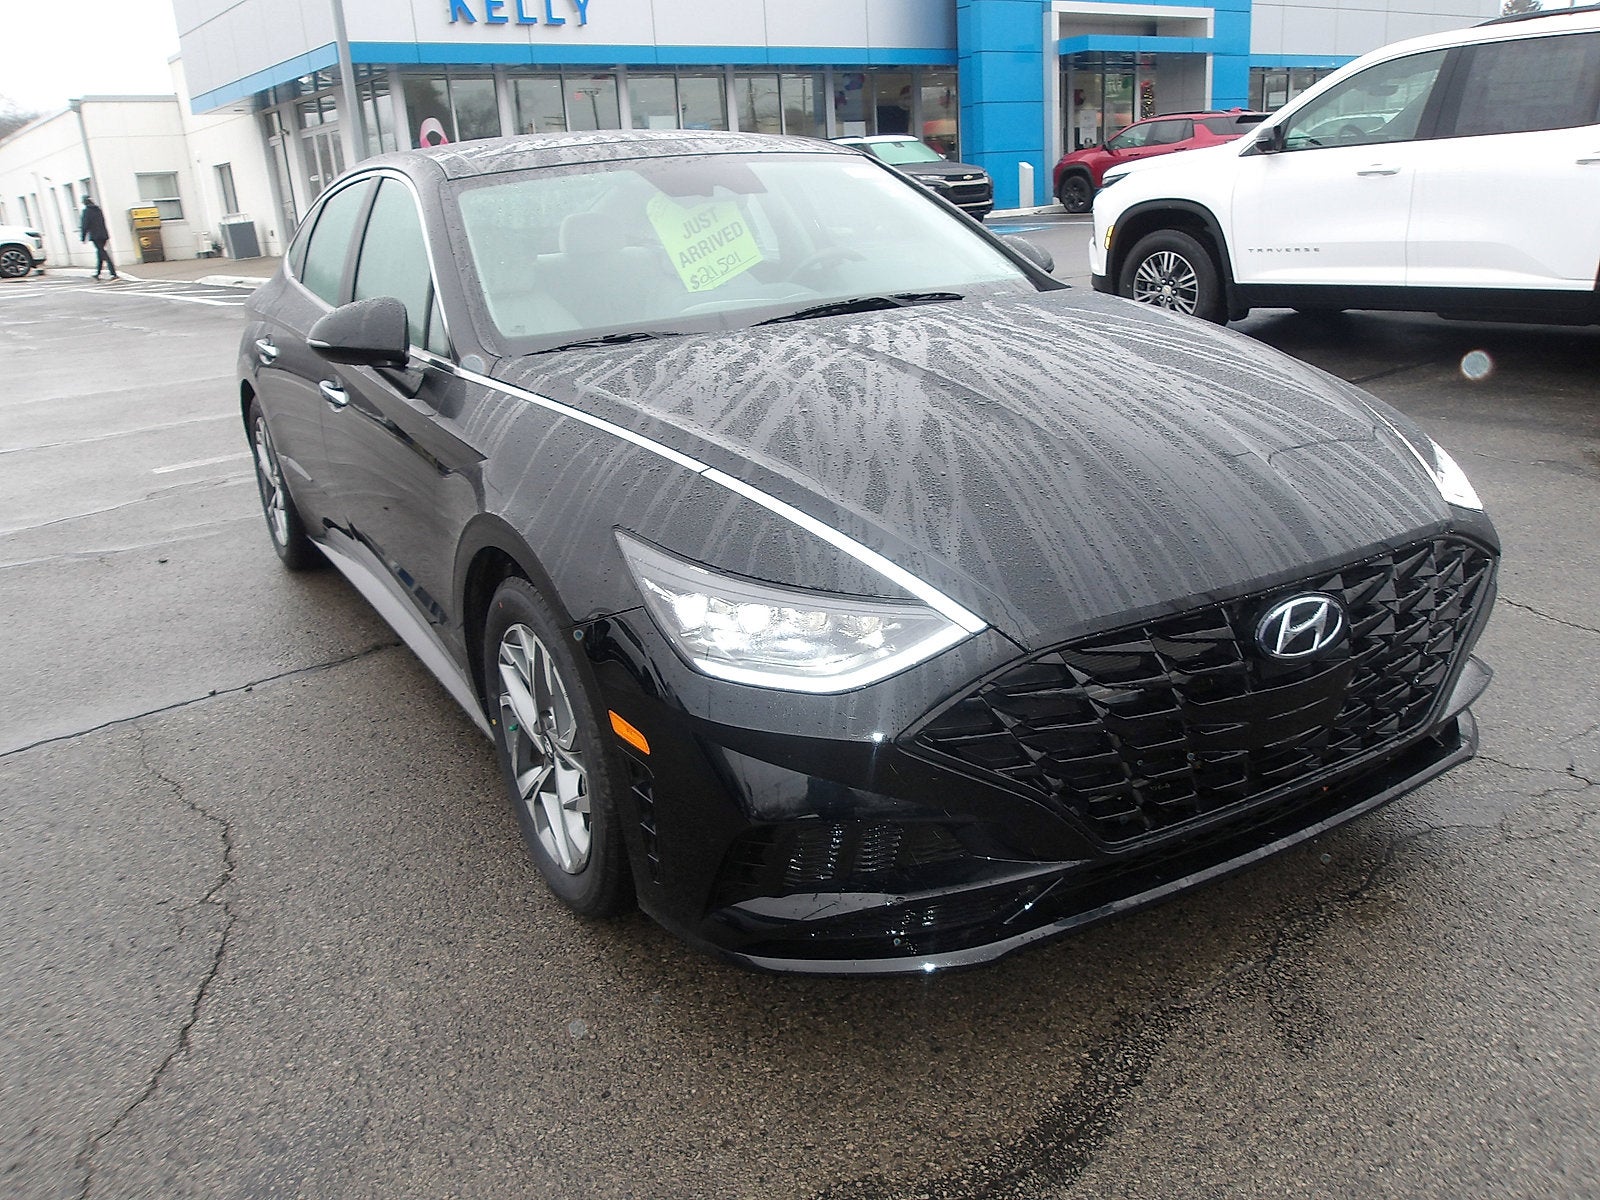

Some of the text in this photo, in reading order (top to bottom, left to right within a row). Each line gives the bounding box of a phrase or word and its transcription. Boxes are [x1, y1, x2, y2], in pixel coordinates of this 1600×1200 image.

[449, 0, 589, 26] KELLY
[682, 206, 719, 239] JUST
[679, 221, 743, 268] ARRIVED
